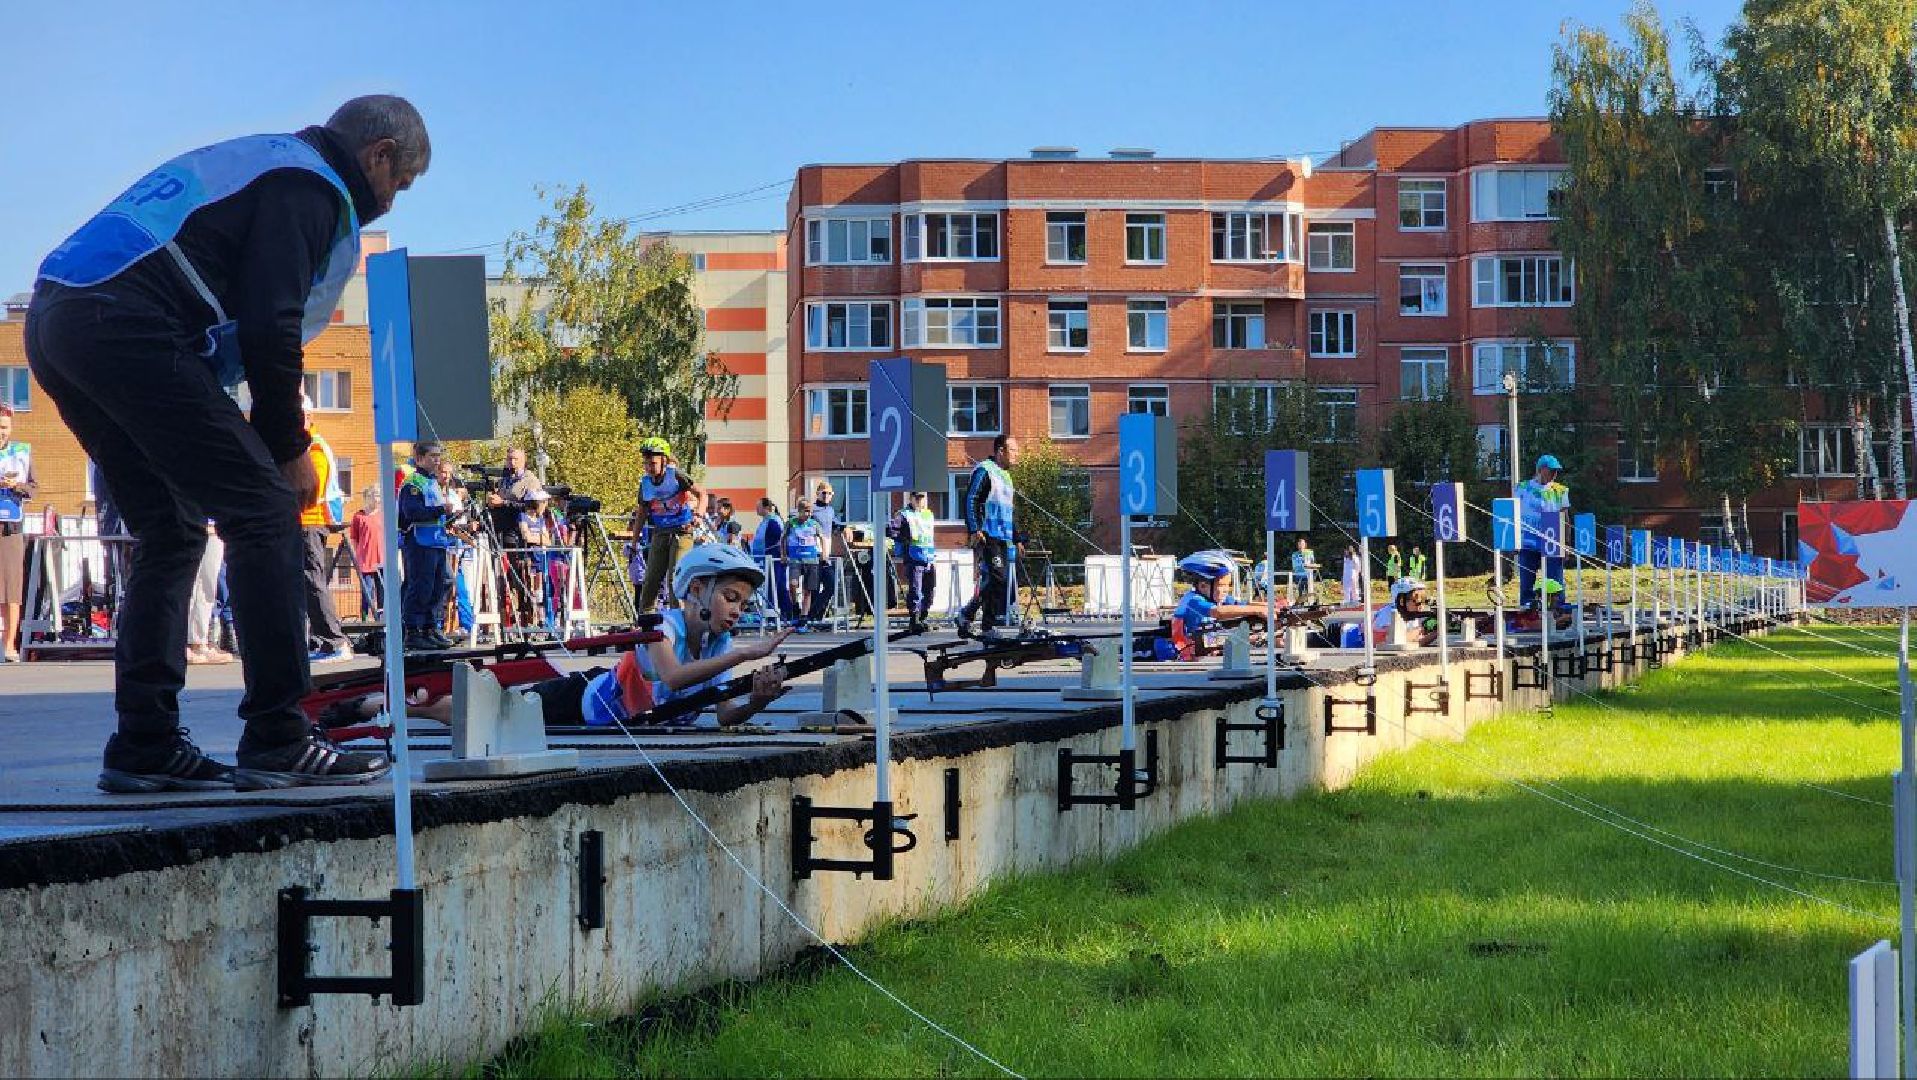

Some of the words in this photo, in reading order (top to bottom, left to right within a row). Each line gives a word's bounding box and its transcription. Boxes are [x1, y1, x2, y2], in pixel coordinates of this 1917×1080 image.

[382, 319, 400, 438] 1
[879, 406, 904, 487] 2
[1126, 450, 1148, 511] 3
[1270, 479, 1290, 529] 4
[1366, 494, 1381, 536] 5
[1438, 503, 1453, 541] 6
[1496, 517, 1511, 550] 7
[1544, 527, 1557, 555] 8
[1579, 527, 1592, 555] 9
[1607, 539, 1622, 564] 10
[1633, 541, 1645, 565] 11
[1653, 547, 1668, 568] 12
